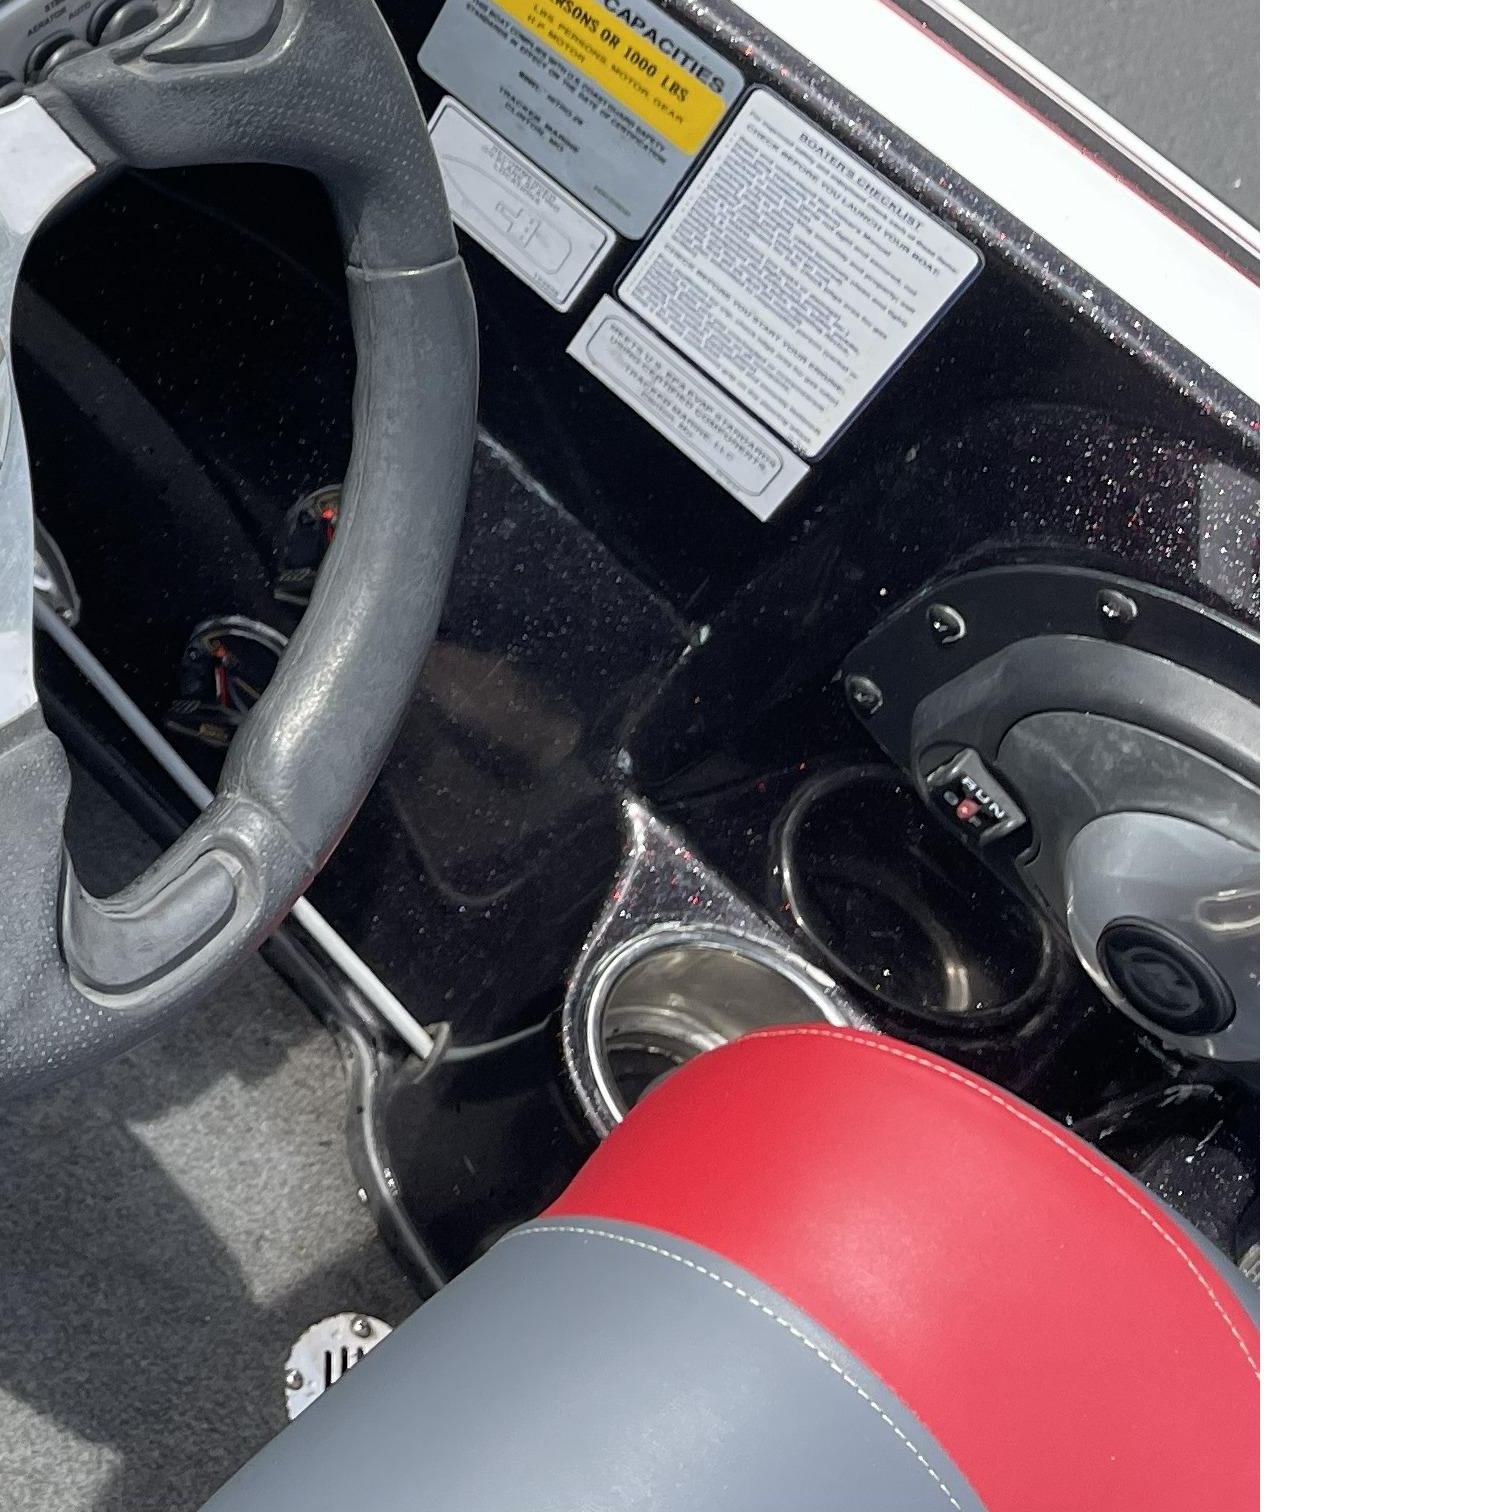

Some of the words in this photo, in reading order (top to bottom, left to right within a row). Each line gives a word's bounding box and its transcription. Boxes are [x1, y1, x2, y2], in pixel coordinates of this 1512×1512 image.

[27, 6, 68, 36] AERATOR
[69, 1, 92, 21] AUTO
[598, 26, 621, 50] OR
[623, 45, 658, 78] 1000
[660, 73, 690, 102] LBS
